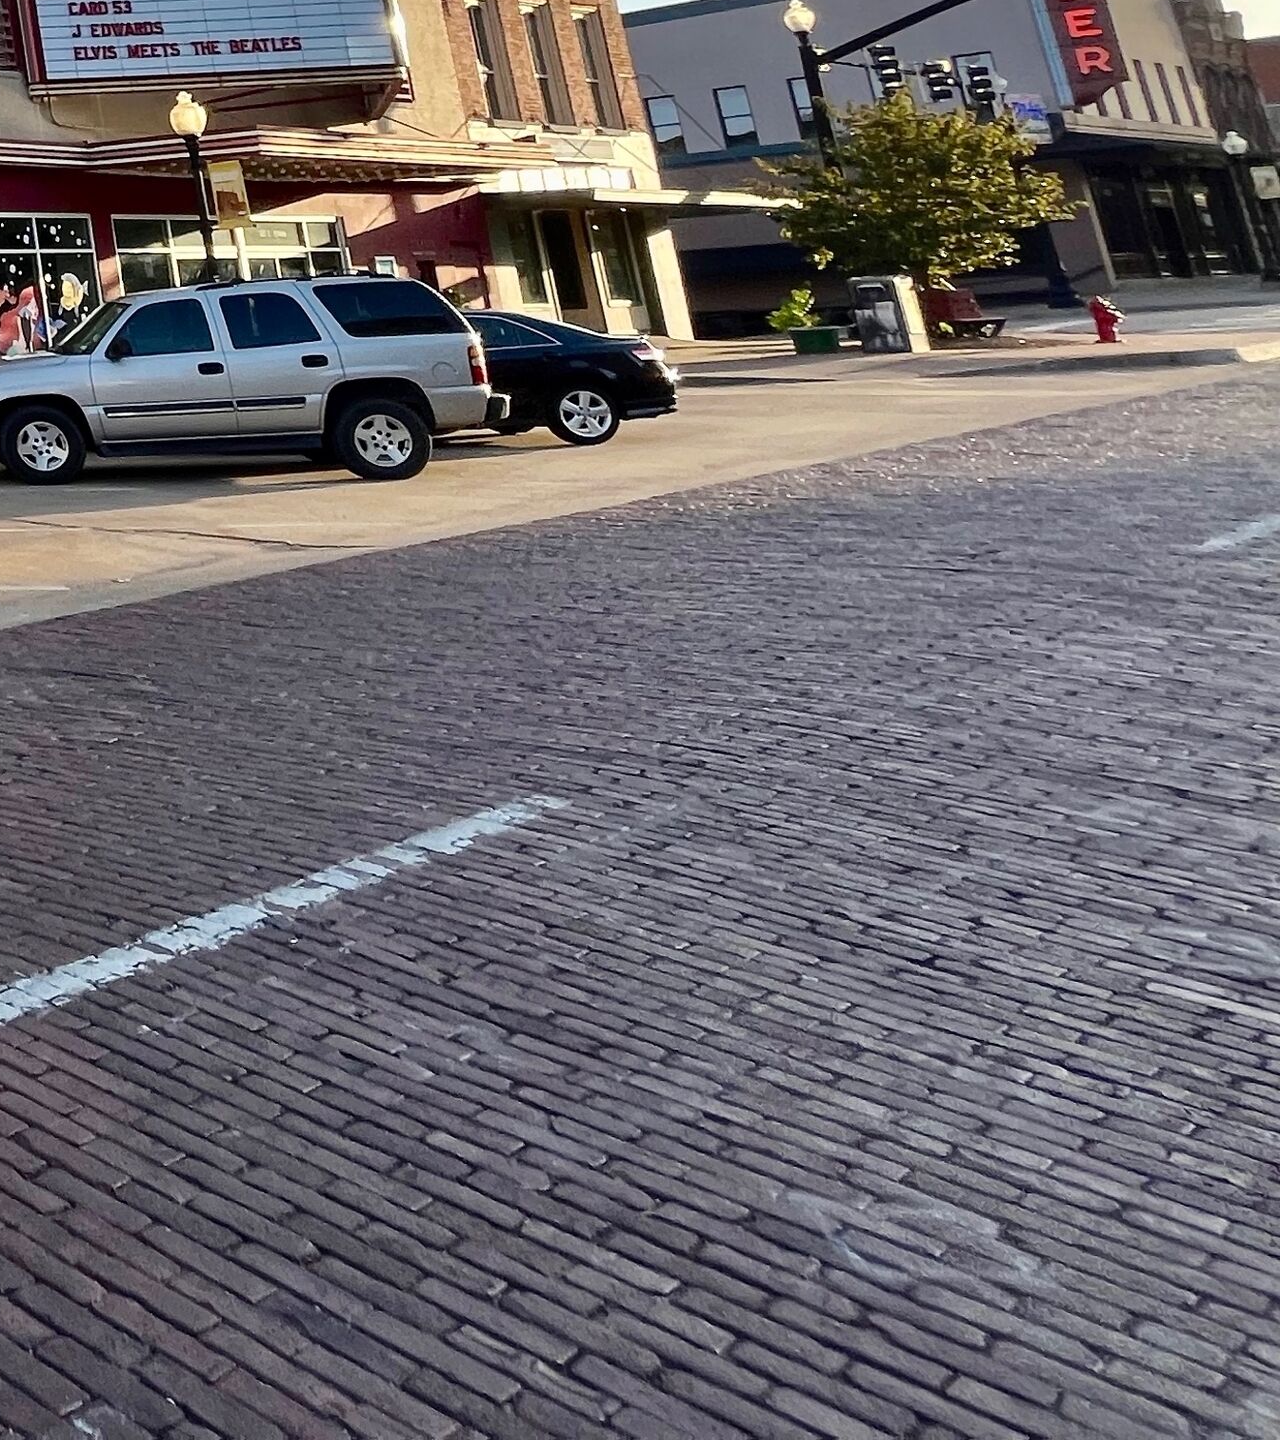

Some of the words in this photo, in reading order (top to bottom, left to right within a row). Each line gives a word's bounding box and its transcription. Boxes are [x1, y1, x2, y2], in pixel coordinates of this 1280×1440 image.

[112, 0, 133, 15] 53
[72, 25, 82, 38] J
[90, 21, 164, 37] EDWARDS
[73, 44, 117, 60] ELVIS
[127, 42, 181, 58] MEETS
[190, 40, 221, 56] THE
[229, 36, 302, 54] BEATLES
